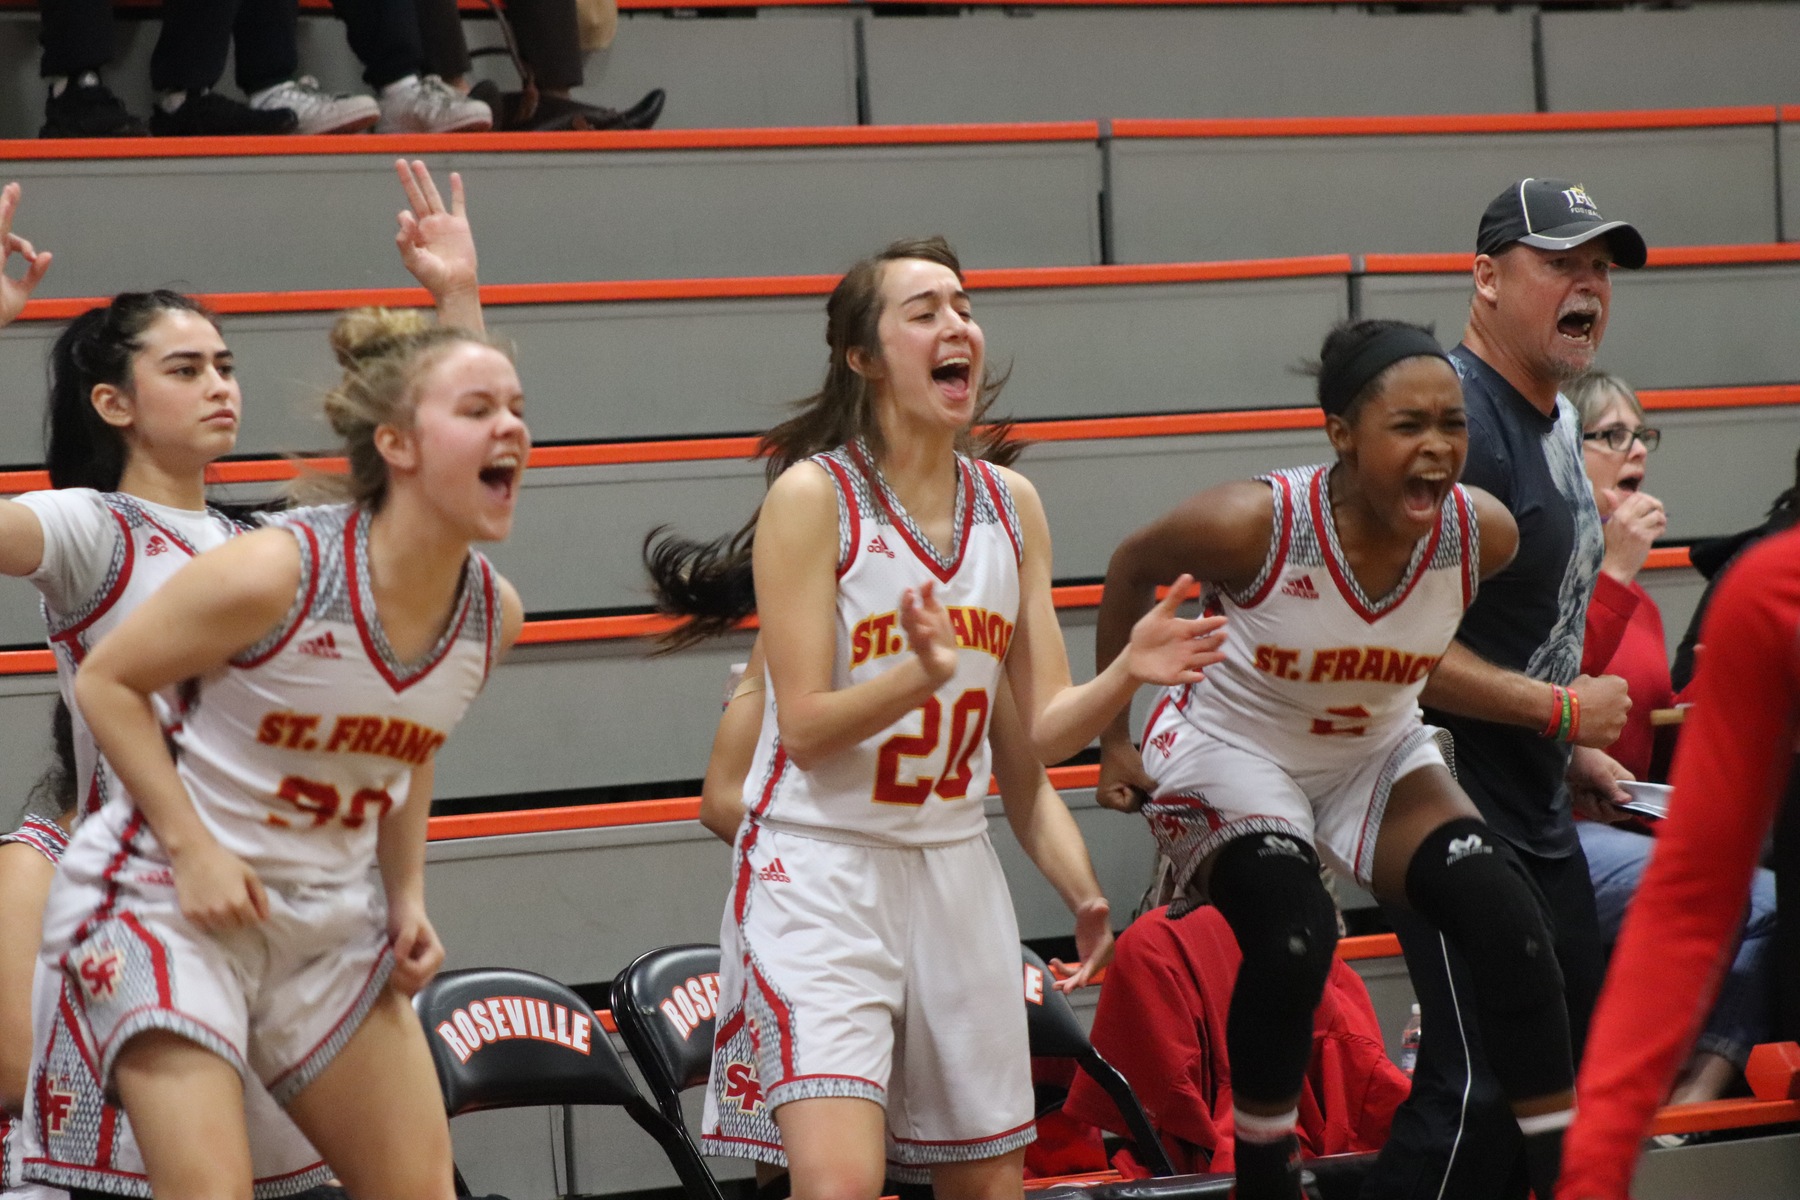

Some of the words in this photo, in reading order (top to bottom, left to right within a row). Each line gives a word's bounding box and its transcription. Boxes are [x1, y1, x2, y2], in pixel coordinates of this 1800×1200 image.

[849, 609, 902, 671] ST.
[1254, 643, 1303, 681] ST.
[256, 710, 321, 751] ST.
[871, 687, 989, 807] 20
[435, 996, 592, 1065] ROSEVILLE
